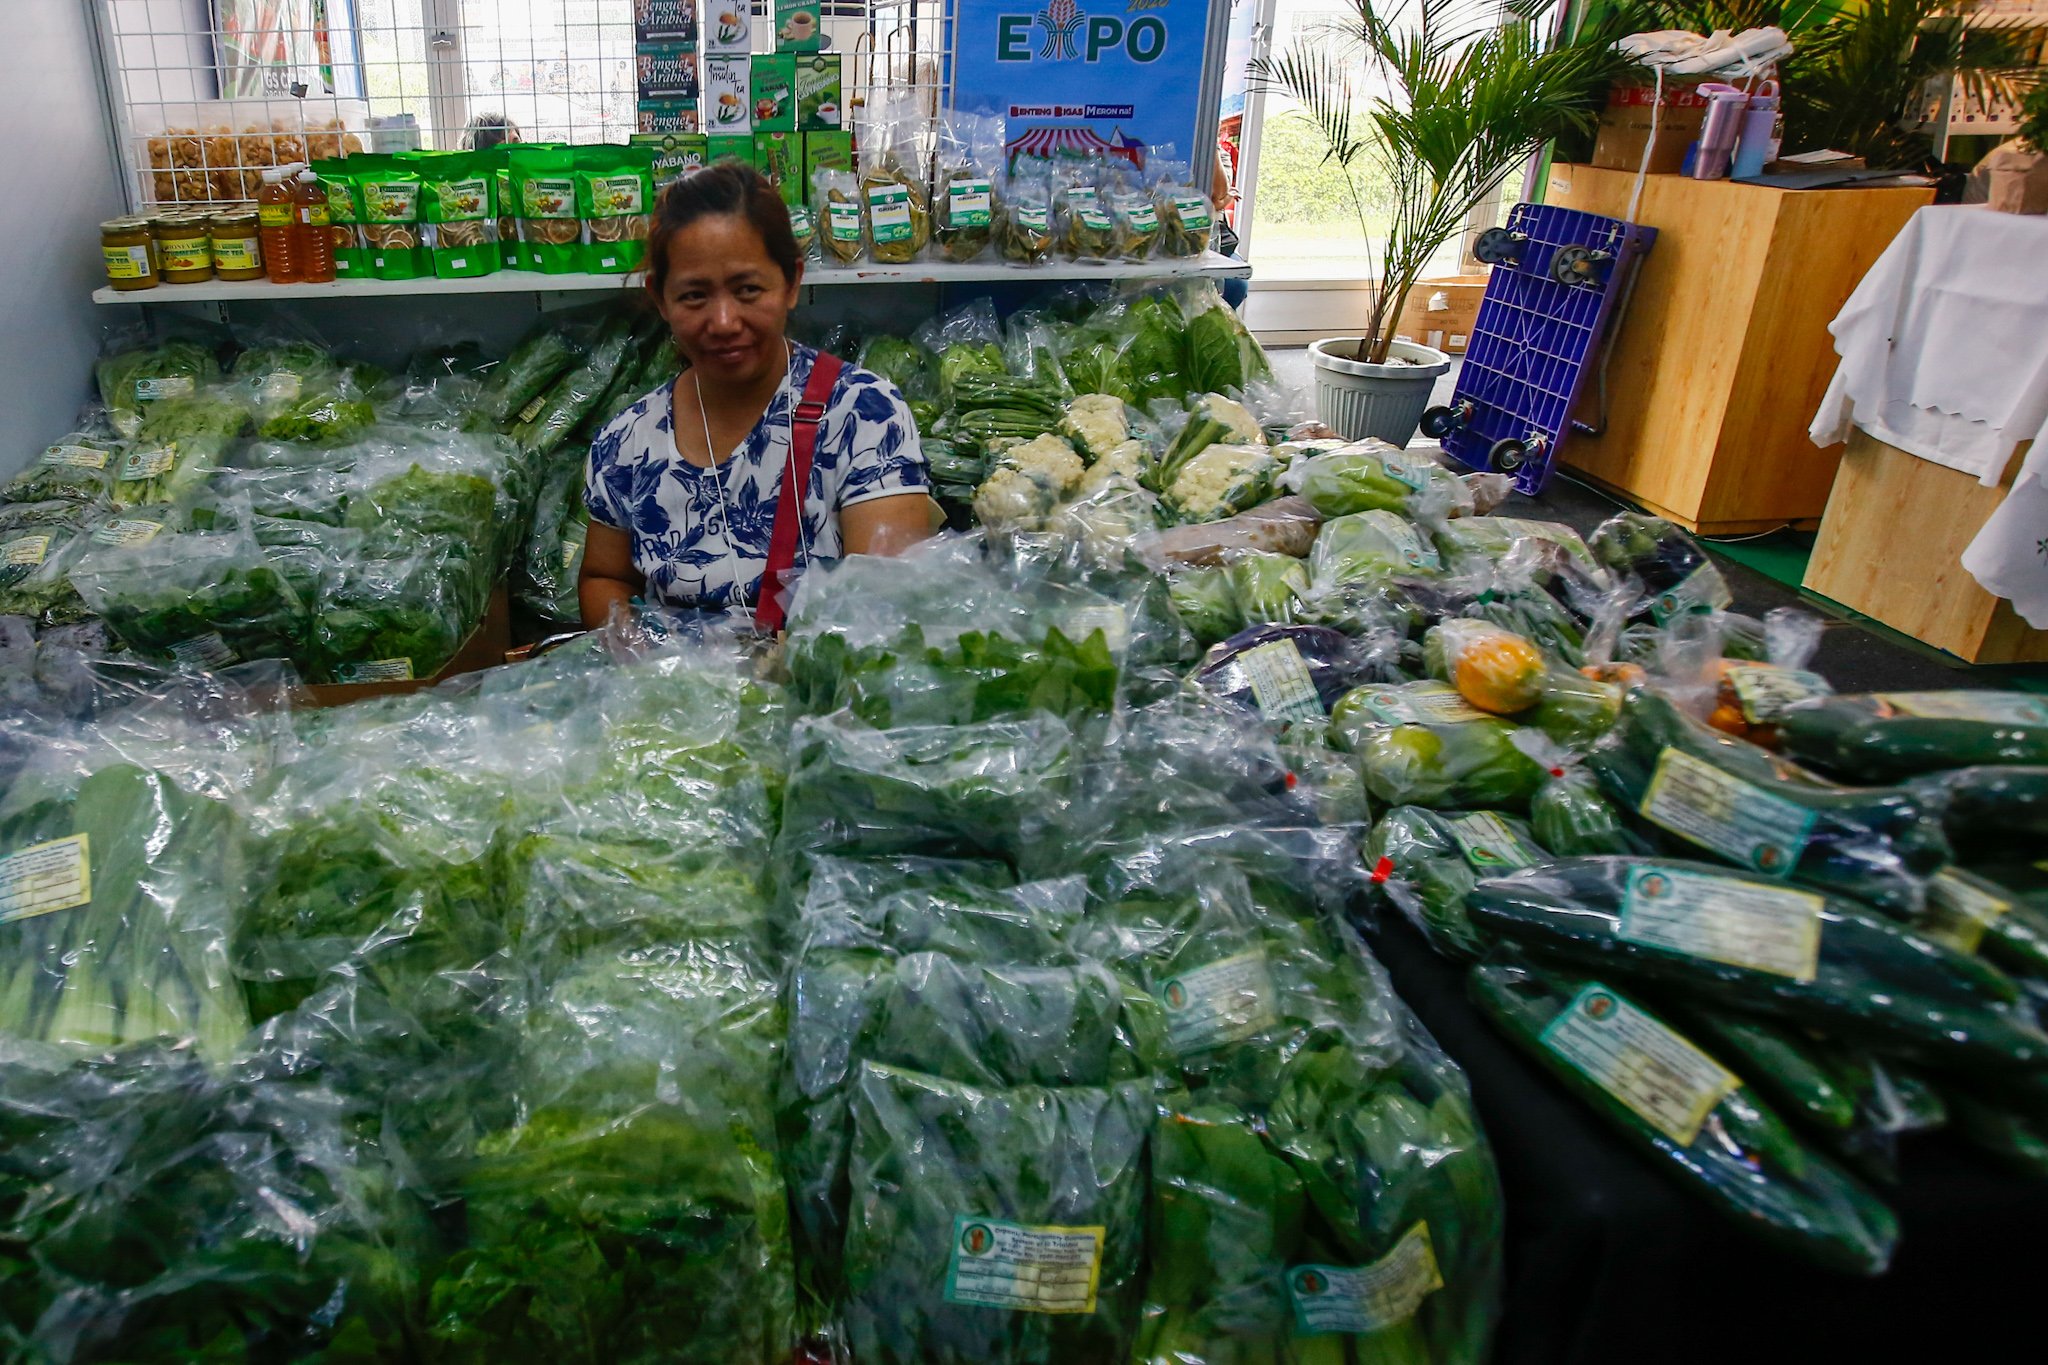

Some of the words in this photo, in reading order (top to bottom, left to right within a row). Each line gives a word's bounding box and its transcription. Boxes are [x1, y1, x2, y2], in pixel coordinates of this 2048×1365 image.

[640, 0, 687, 14] Benguet
[638, 9, 692, 26] Arabica
[997, 11, 1168, 64] EXPO
[641, 56, 689, 73] Benguet
[640, 68, 694, 84] Arabica
[708, 63, 736, 85] Insulin
[731, 79, 745, 99] Tea
[1054, 105, 1083, 117] BIGAS
[1086, 105, 1117, 117] MERON
[1118, 106, 1132, 115] na!
[643, 112, 691, 130] Benguet
